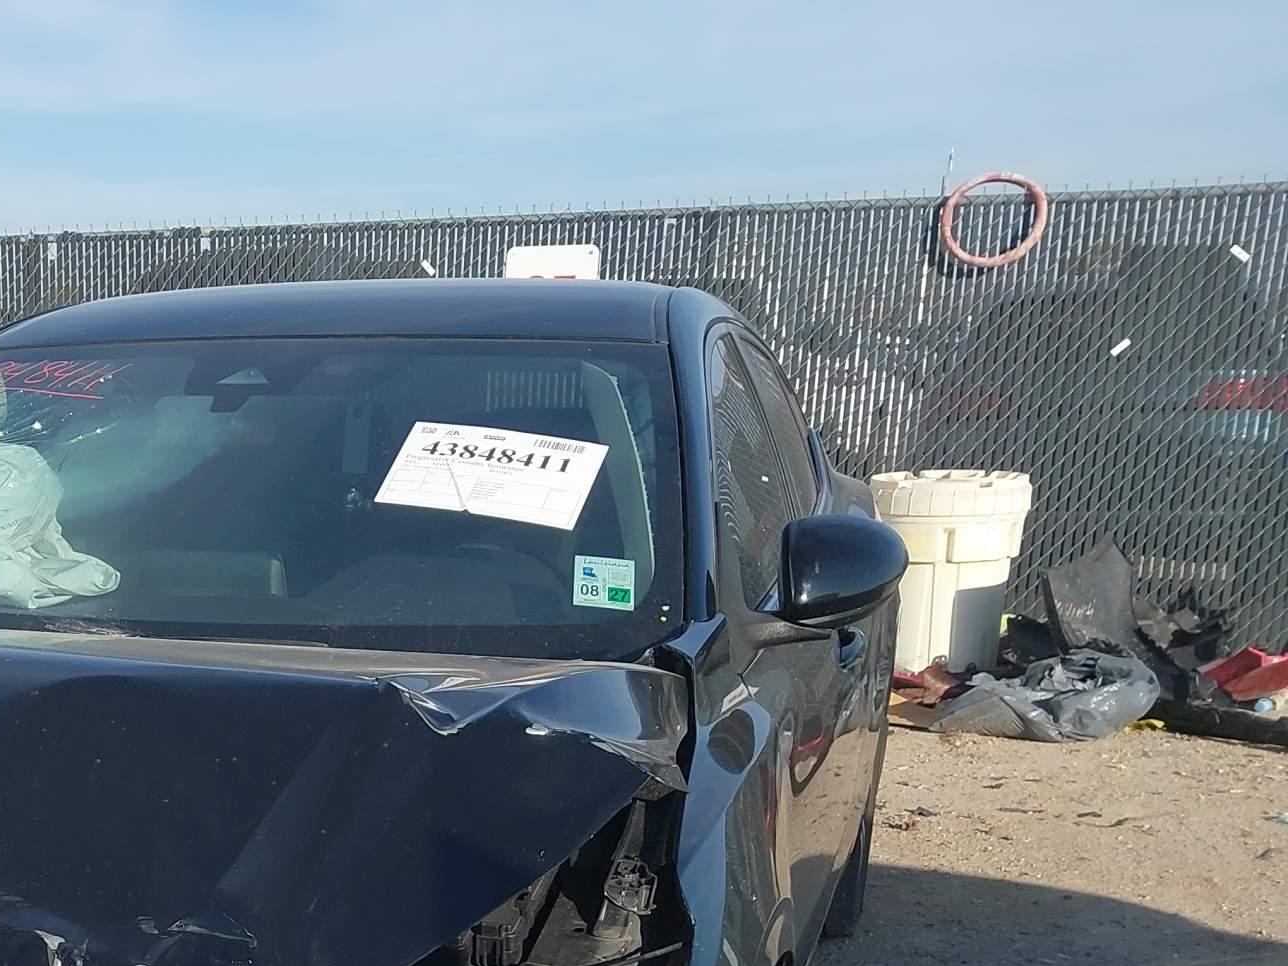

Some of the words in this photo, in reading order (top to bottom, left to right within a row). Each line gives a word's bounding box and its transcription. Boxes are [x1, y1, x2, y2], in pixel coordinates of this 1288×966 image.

[421, 441, 571, 474] 43848411
[580, 583, 599, 597] 08
[609, 589, 629, 603] 27
